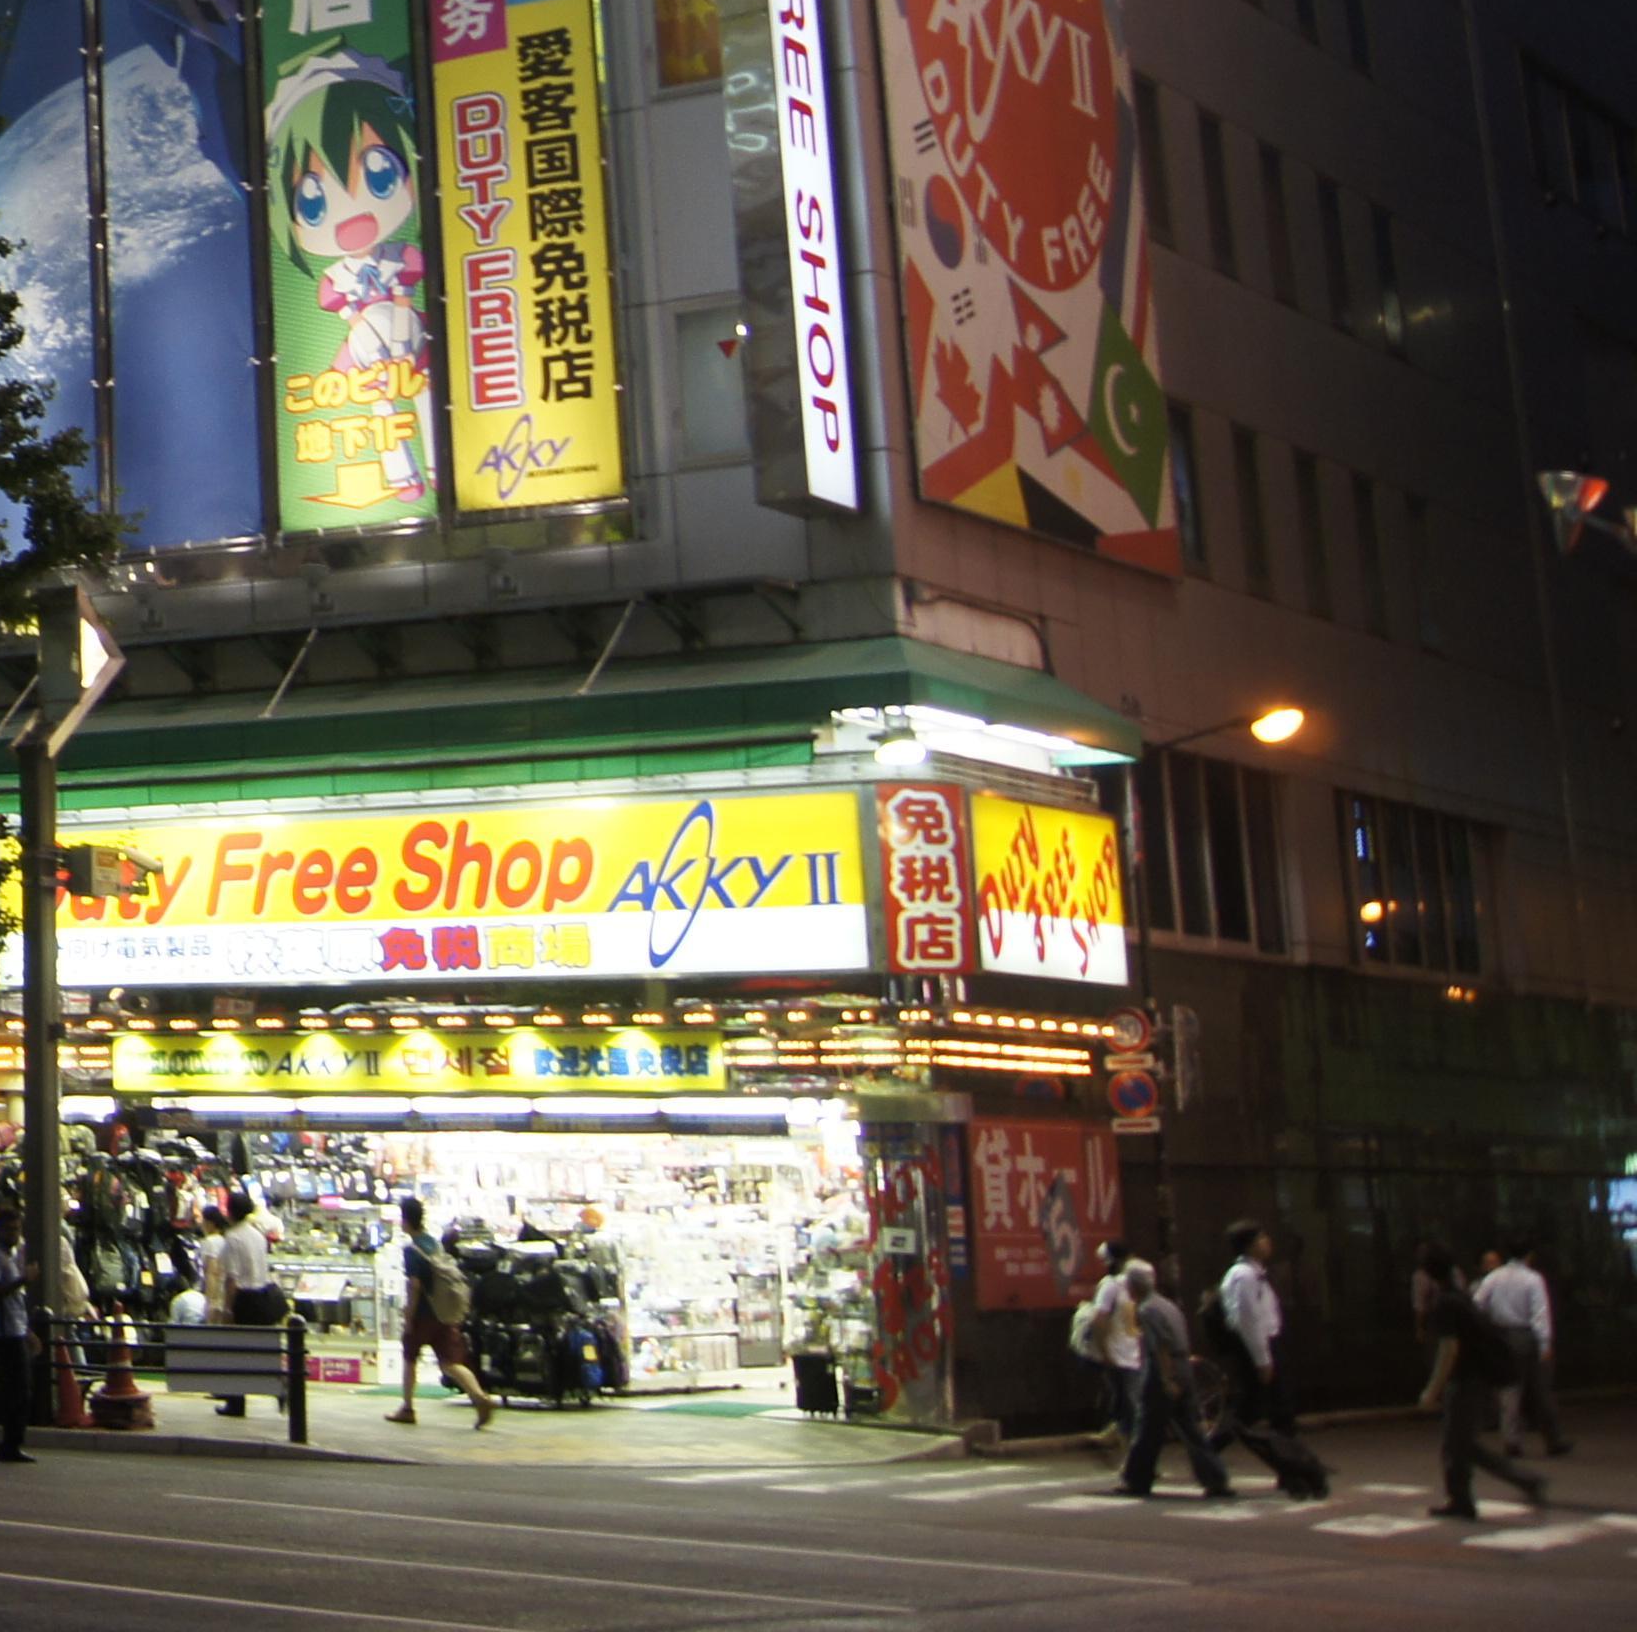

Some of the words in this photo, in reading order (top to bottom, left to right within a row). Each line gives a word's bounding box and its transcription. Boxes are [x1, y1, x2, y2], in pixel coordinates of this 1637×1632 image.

[451, 92, 512, 246] DUTY
[1041, 141, 1113, 284] FREE
[283, 359, 429, 417] このビル
[461, 247, 525, 412] FREE
[795, 186, 842, 456] SHOP
[292, 410, 419, 464] 地下1F
[206, 831, 379, 918] Free
[394, 818, 595, 914] Shop
[887, 789, 963, 967] 免税店
[56, 933, 214, 961] 向け電気製品
